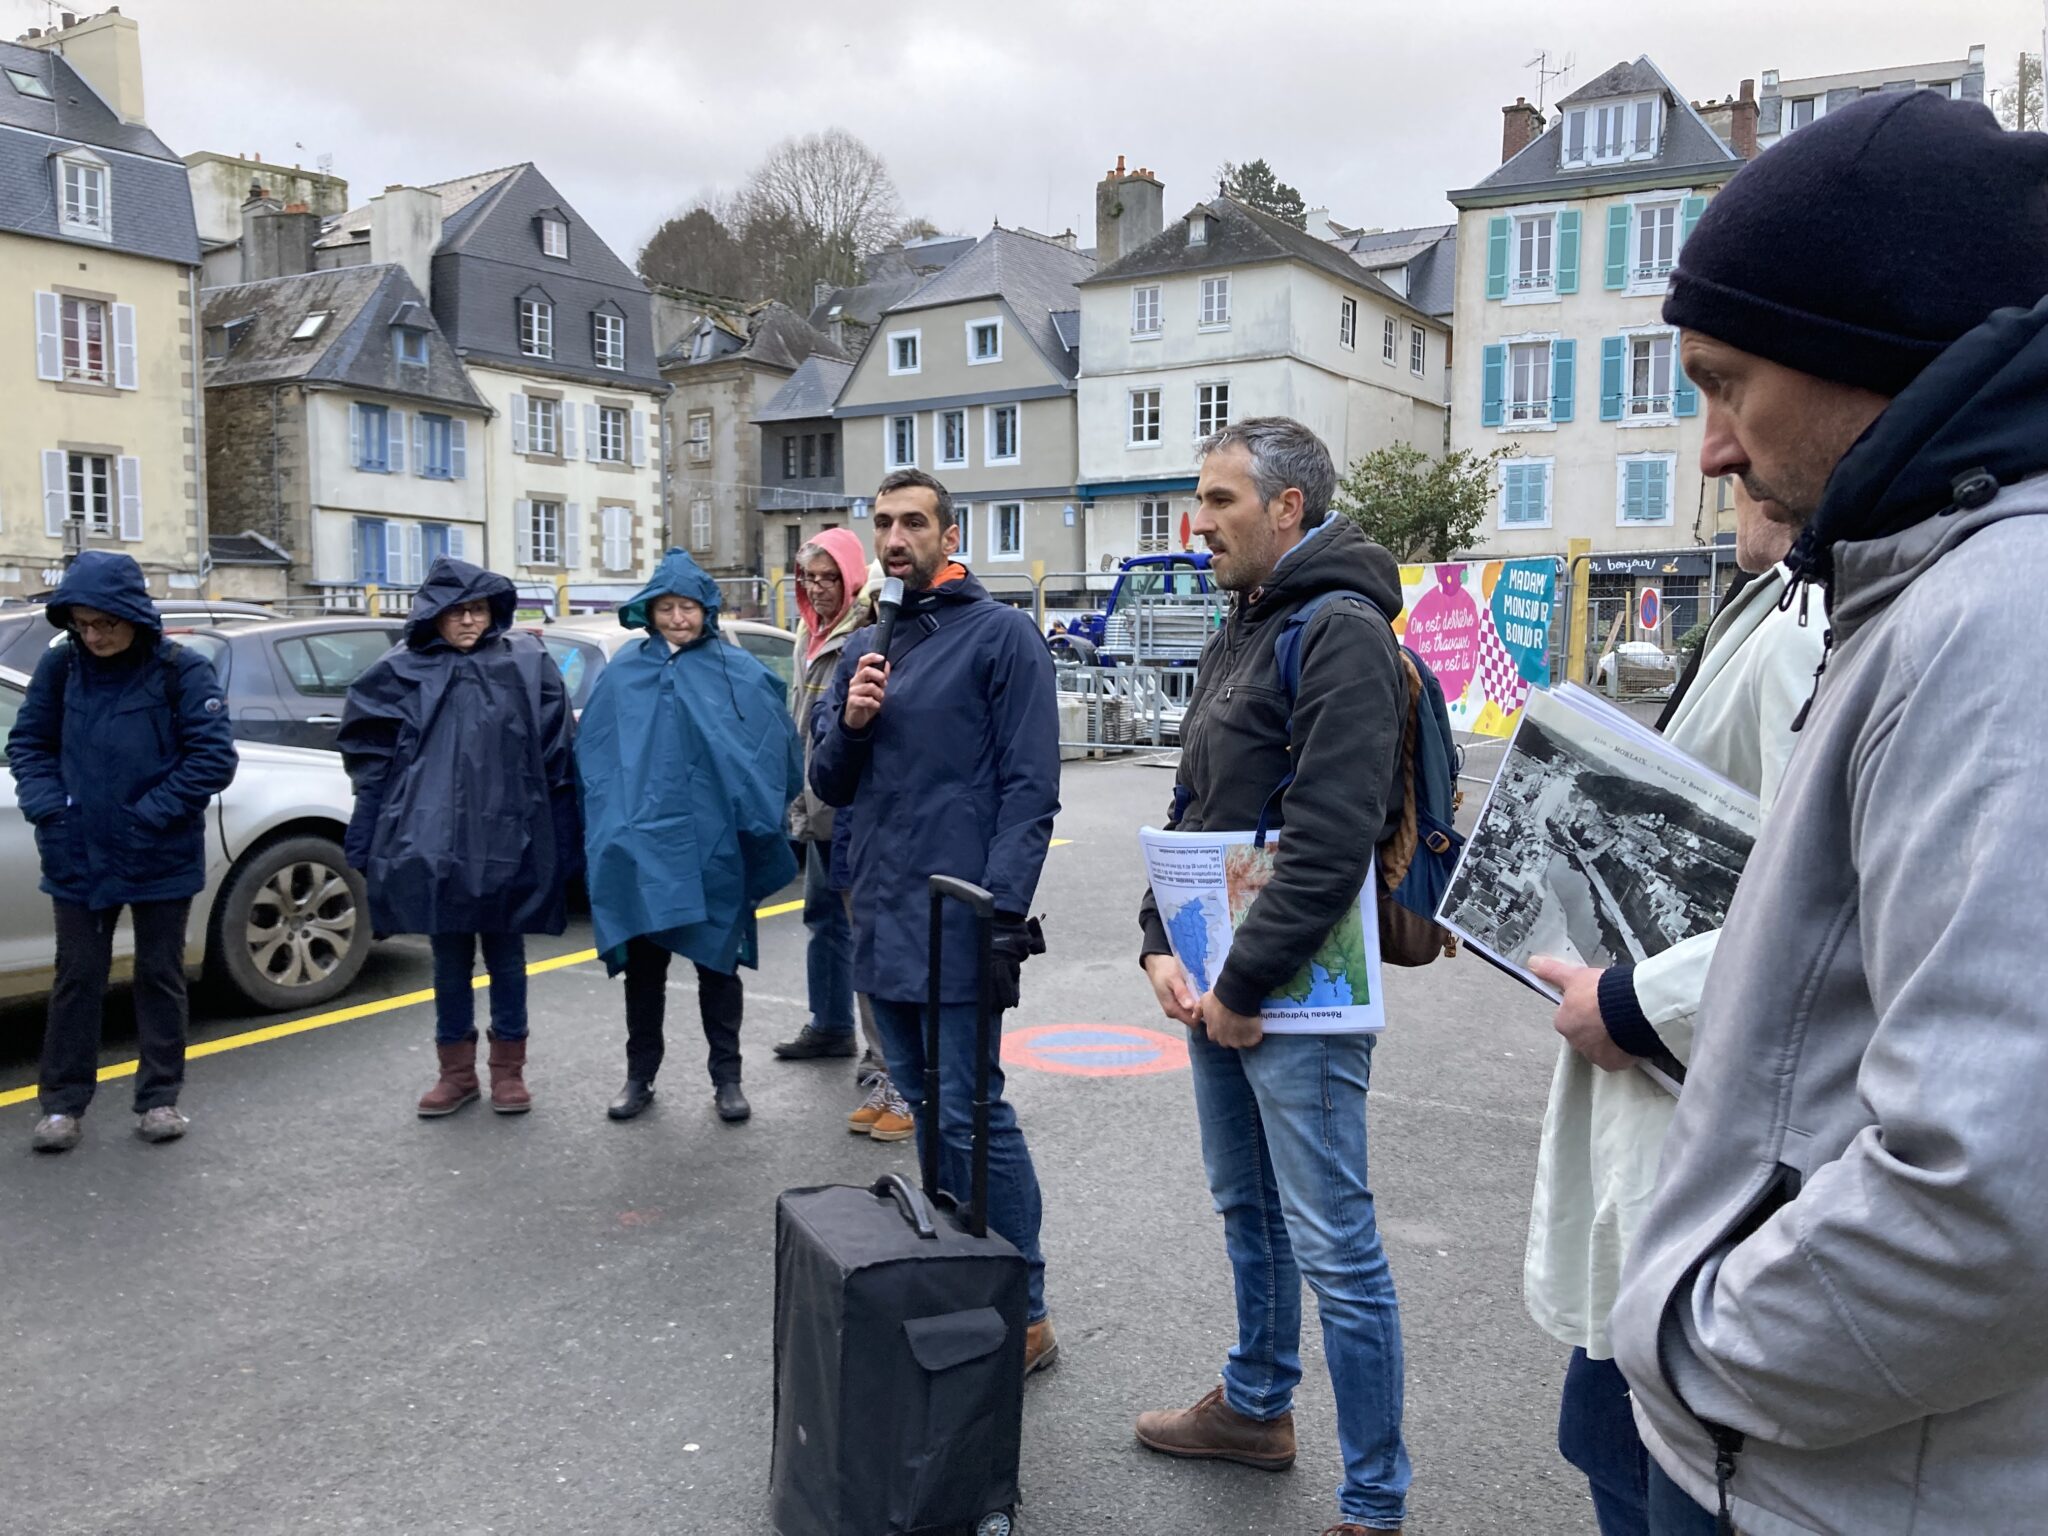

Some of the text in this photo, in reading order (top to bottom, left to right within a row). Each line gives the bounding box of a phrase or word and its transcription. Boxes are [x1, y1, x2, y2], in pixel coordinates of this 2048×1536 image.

[1410, 616, 1423, 635] On
[1425, 612, 1441, 633] est
[1505, 621, 1543, 649] BONJOR
[1418, 632, 1470, 653] les travaux
[1432, 659, 1443, 673] on
[1445, 651, 1460, 671] est
[1461, 650, 1470, 670] là
